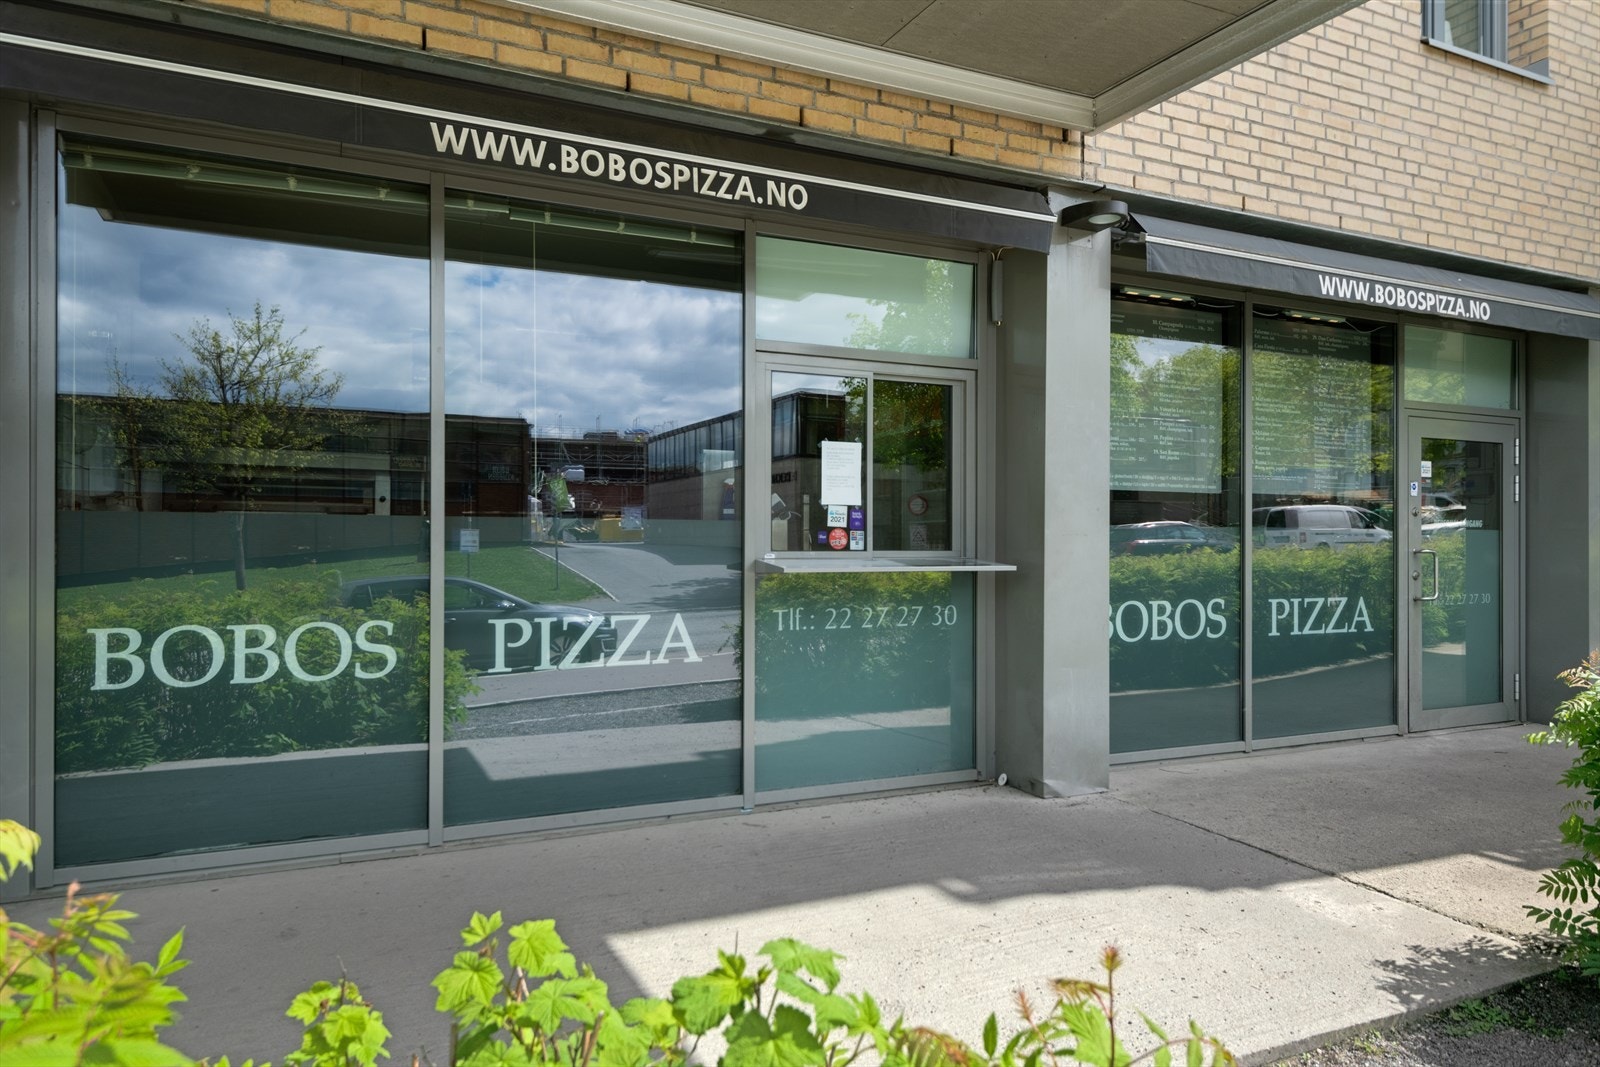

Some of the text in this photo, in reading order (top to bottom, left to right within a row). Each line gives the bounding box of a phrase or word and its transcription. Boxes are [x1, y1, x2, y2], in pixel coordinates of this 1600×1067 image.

[430, 121, 808, 211] WWW.BOBOSPIZZA.NO
[1318, 274, 1491, 321] WWW.BOBOSPIZZA.NO
[772, 604, 958, 631] Tlf.: 22 27 27 30
[1108, 596, 1374, 643] OBOS PIZZA
[1469, 593, 1479, 604] 27
[1481, 593, 1490, 604] 30
[87, 613, 703, 691] BOBOS PIZZA
